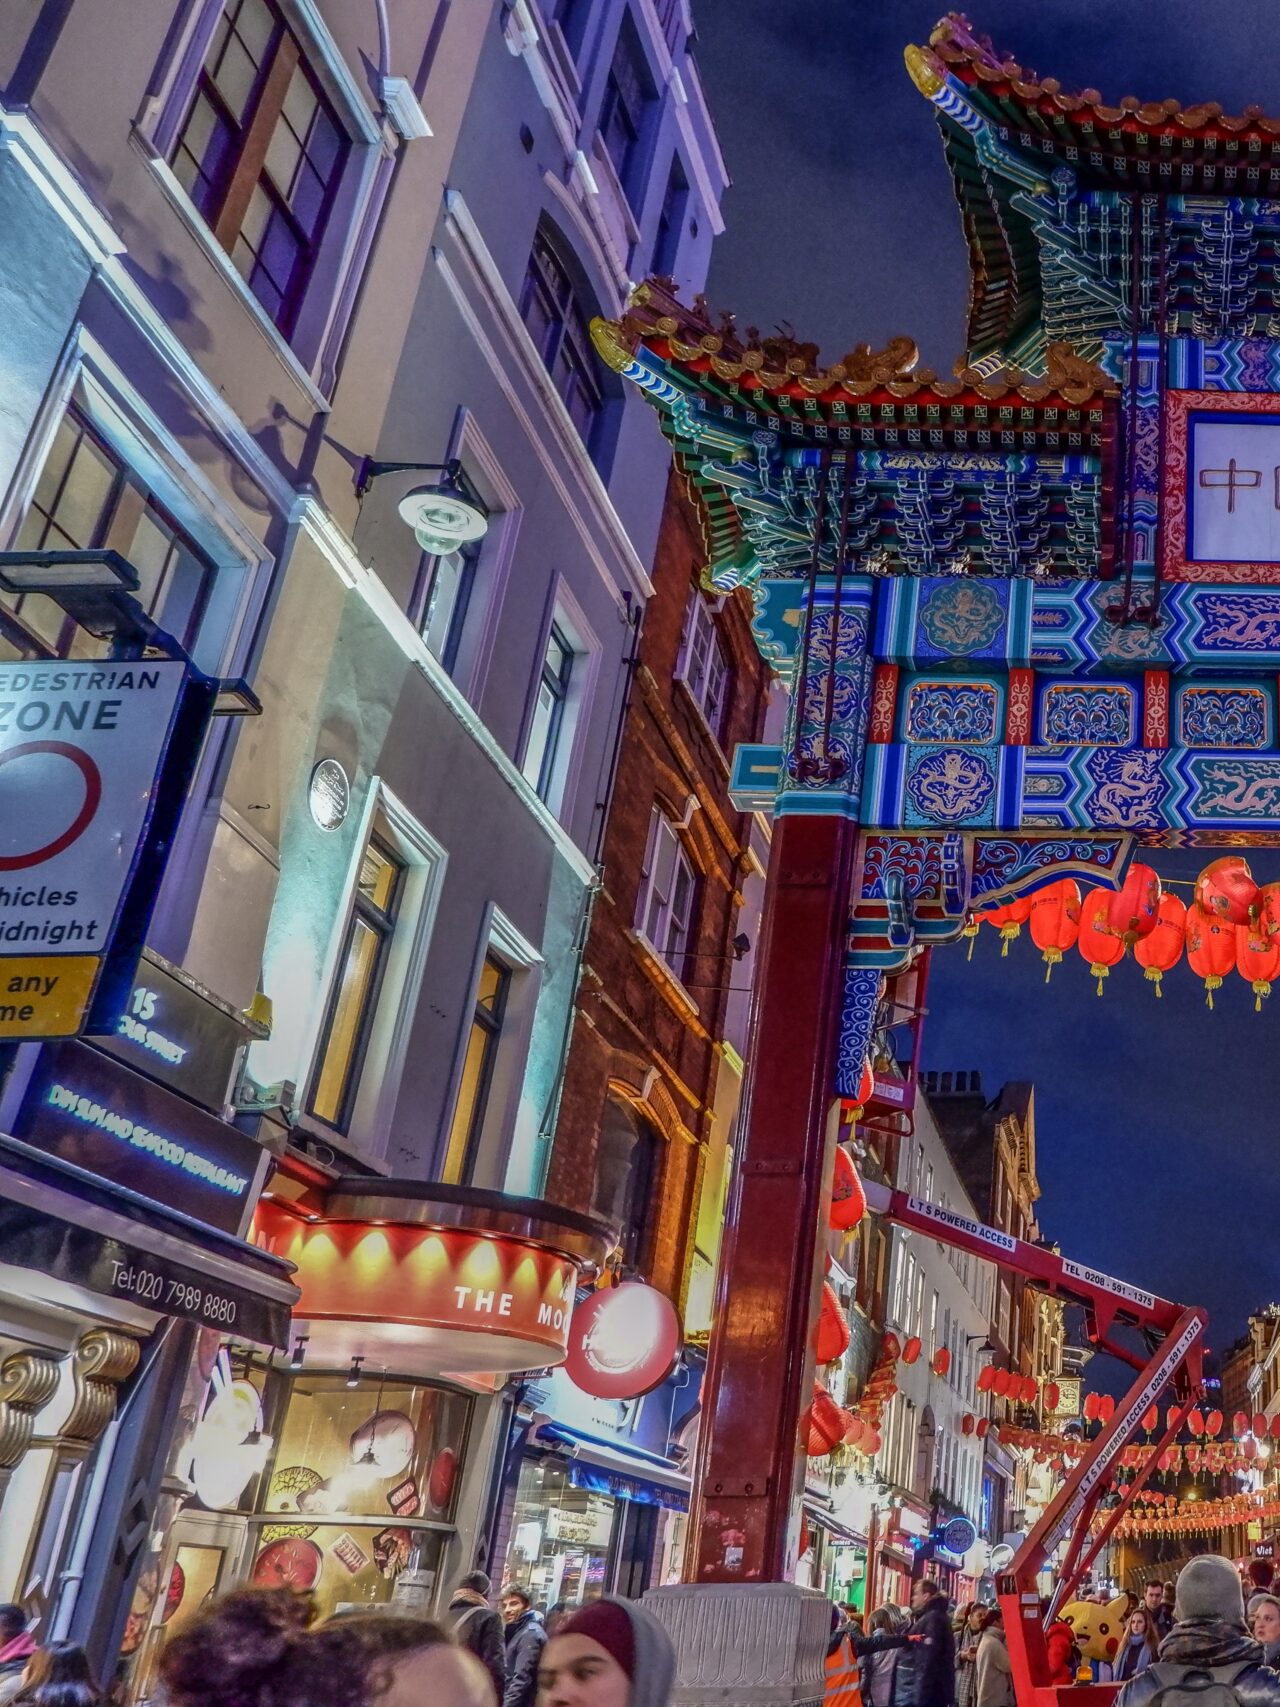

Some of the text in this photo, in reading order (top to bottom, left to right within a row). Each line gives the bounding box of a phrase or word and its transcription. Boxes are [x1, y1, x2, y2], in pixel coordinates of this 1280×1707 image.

[0, 700, 122, 732] ZONE
[0, 886, 78, 907] hicles
[7, 976, 59, 996] any
[133, 988, 157, 1020] 15
[49, 1085, 79, 1112] DIM
[101, 1113, 133, 1139] AND
[130, 1126, 185, 1165] SEAFOOD
[934, 1208, 977, 1233] POWERED
[979, 1227, 1013, 1249] ACCESS
[1065, 1262, 1080, 1277] TEL
[1085, 1271, 1105, 1287] 0208
[1112, 1282, 1126, 1294] 591
[1134, 1291, 1152, 1306] 1375
[165, 1280, 201, 1311] 7989
[203, 1293, 236, 1323] 8880
[454, 1285, 513, 1316] THE
[1096, 1426, 1127, 1470] POWERED
[1126, 1392, 1150, 1428] ACCESS
[1151, 1368, 1168, 1391] 0208
[1169, 1347, 1182, 1365] 591
[1184, 1321, 1200, 1342] 1375
[1256, 1545, 1273, 1555] Viet
